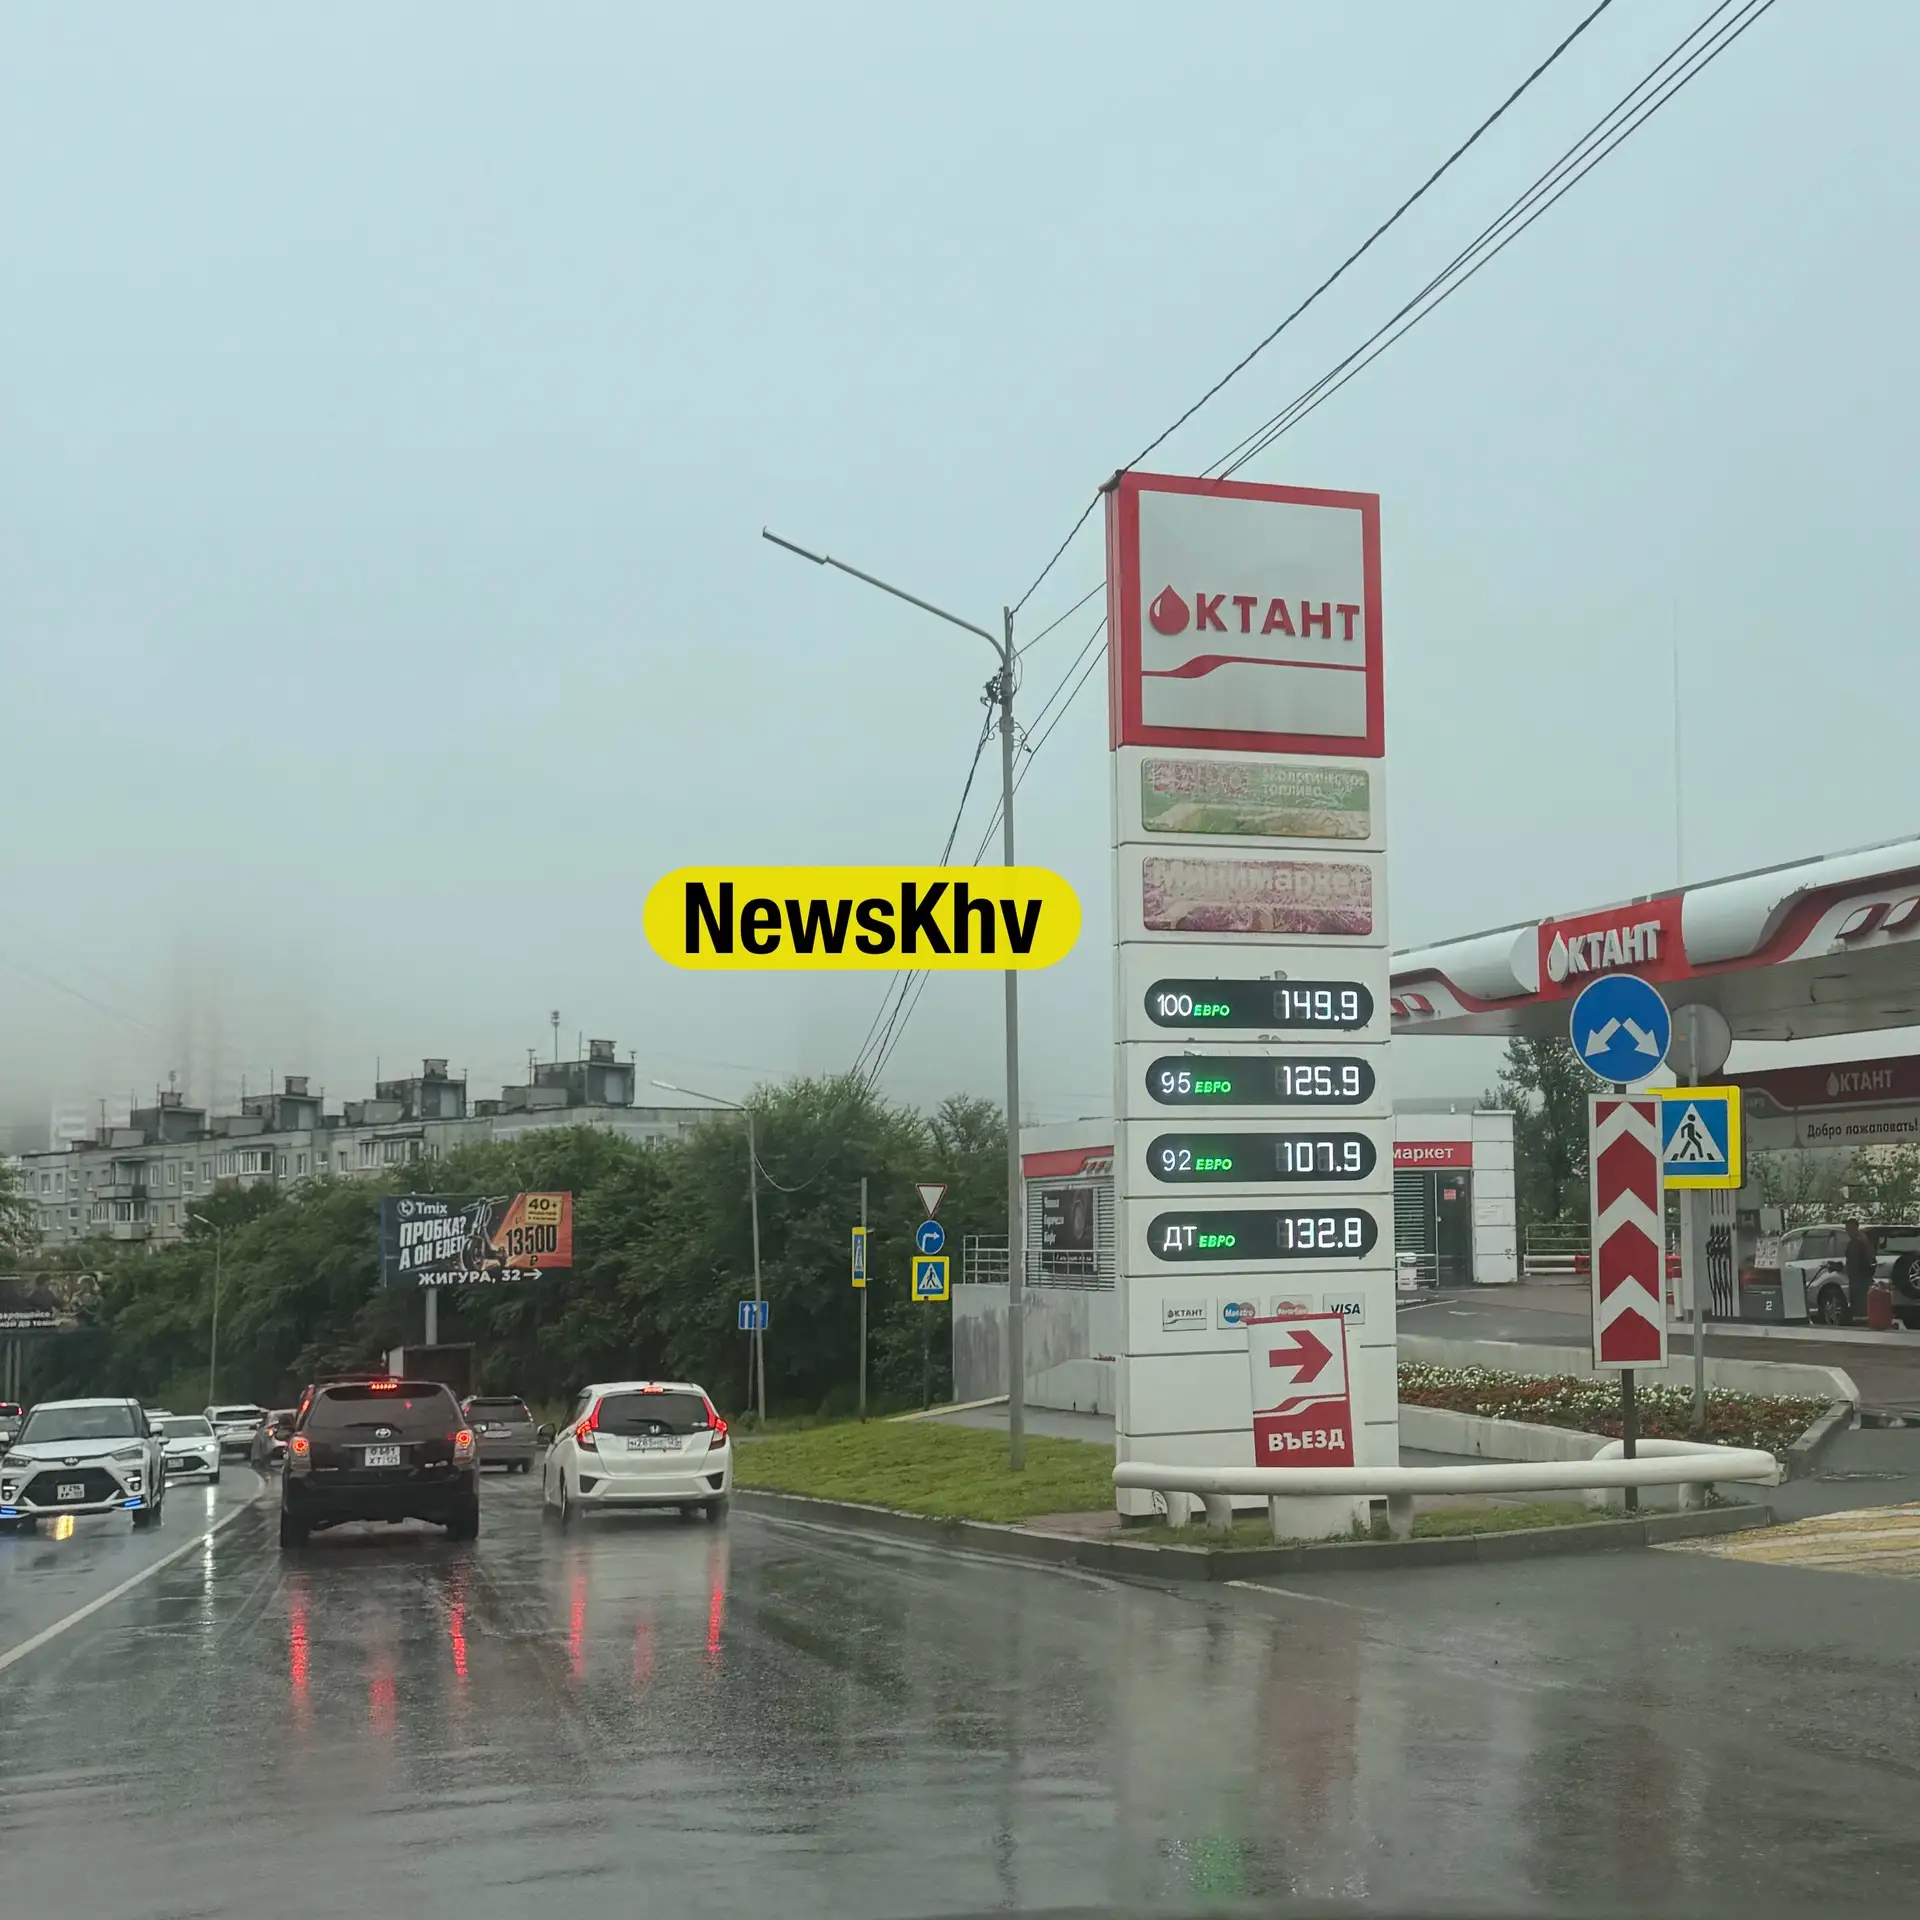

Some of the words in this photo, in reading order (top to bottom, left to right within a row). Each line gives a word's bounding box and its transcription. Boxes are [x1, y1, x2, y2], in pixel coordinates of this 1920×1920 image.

[1157, 993, 1192, 1017] 100
[1193, 1003, 1230, 1017] ЕВРО
[1281, 989, 1359, 1022] 149.9
[1161, 1072, 1191, 1094] 95
[1193, 1080, 1231, 1094] ЕВРО
[1283, 1066, 1360, 1096] 125.9
[1807, 1123, 1842, 1140] Добро
[1162, 1149, 1191, 1171] 92
[1194, 1156, 1232, 1171] ЕВРО
[1284, 1142, 1361, 1172] 107.9
[415, 1201, 448, 1215] Tmix
[528, 1198, 557, 1210] 40+
[400, 1216, 467, 1247] ПРОБКА?
[506, 1224, 557, 1257] 13500
[1162, 1224, 1198, 1251] ДТ
[1198, 1234, 1236, 1248] ЕВРО
[1285, 1217, 1362, 1249] 132.8
[399, 1248, 411, 1271] А
[414, 1243, 432, 1266] ОН
[418, 1271, 496, 1285] ЖИГУРА,
[501, 1269, 521, 1281] 32
[1330, 1303, 1361, 1315] VISA
[1765, 1300, 1773, 1310] 2
[1268, 1428, 1345, 1452] ВЪЕЗД
